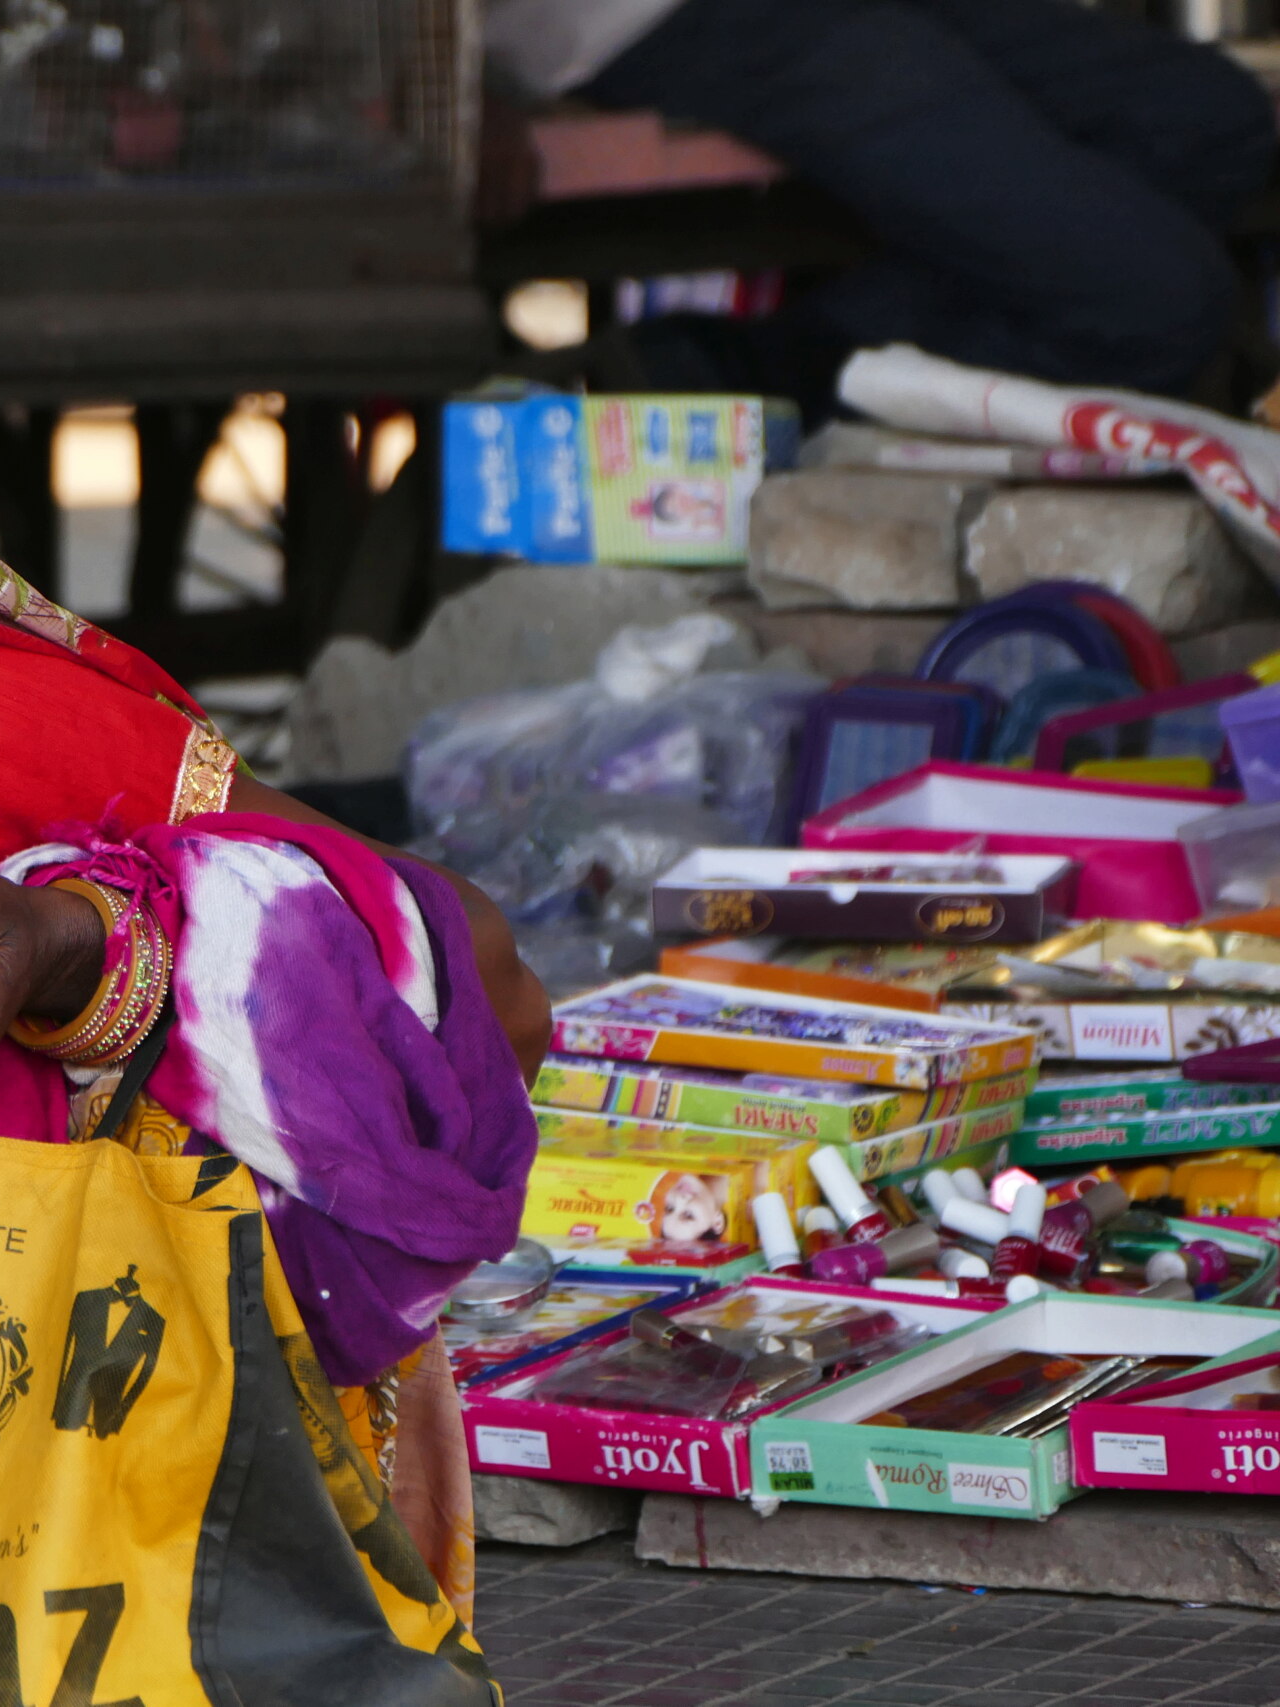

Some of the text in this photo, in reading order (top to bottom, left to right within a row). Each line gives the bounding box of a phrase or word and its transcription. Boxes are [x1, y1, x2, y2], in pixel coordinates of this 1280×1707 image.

[1083, 1024, 1164, 1047] Million
[734, 1104, 818, 1135] SAFARI
[598, 1430, 667, 1446] Lingerie
[601, 1438, 709, 1487] Jyoti
[953, 1471, 1029, 1501] Shree
